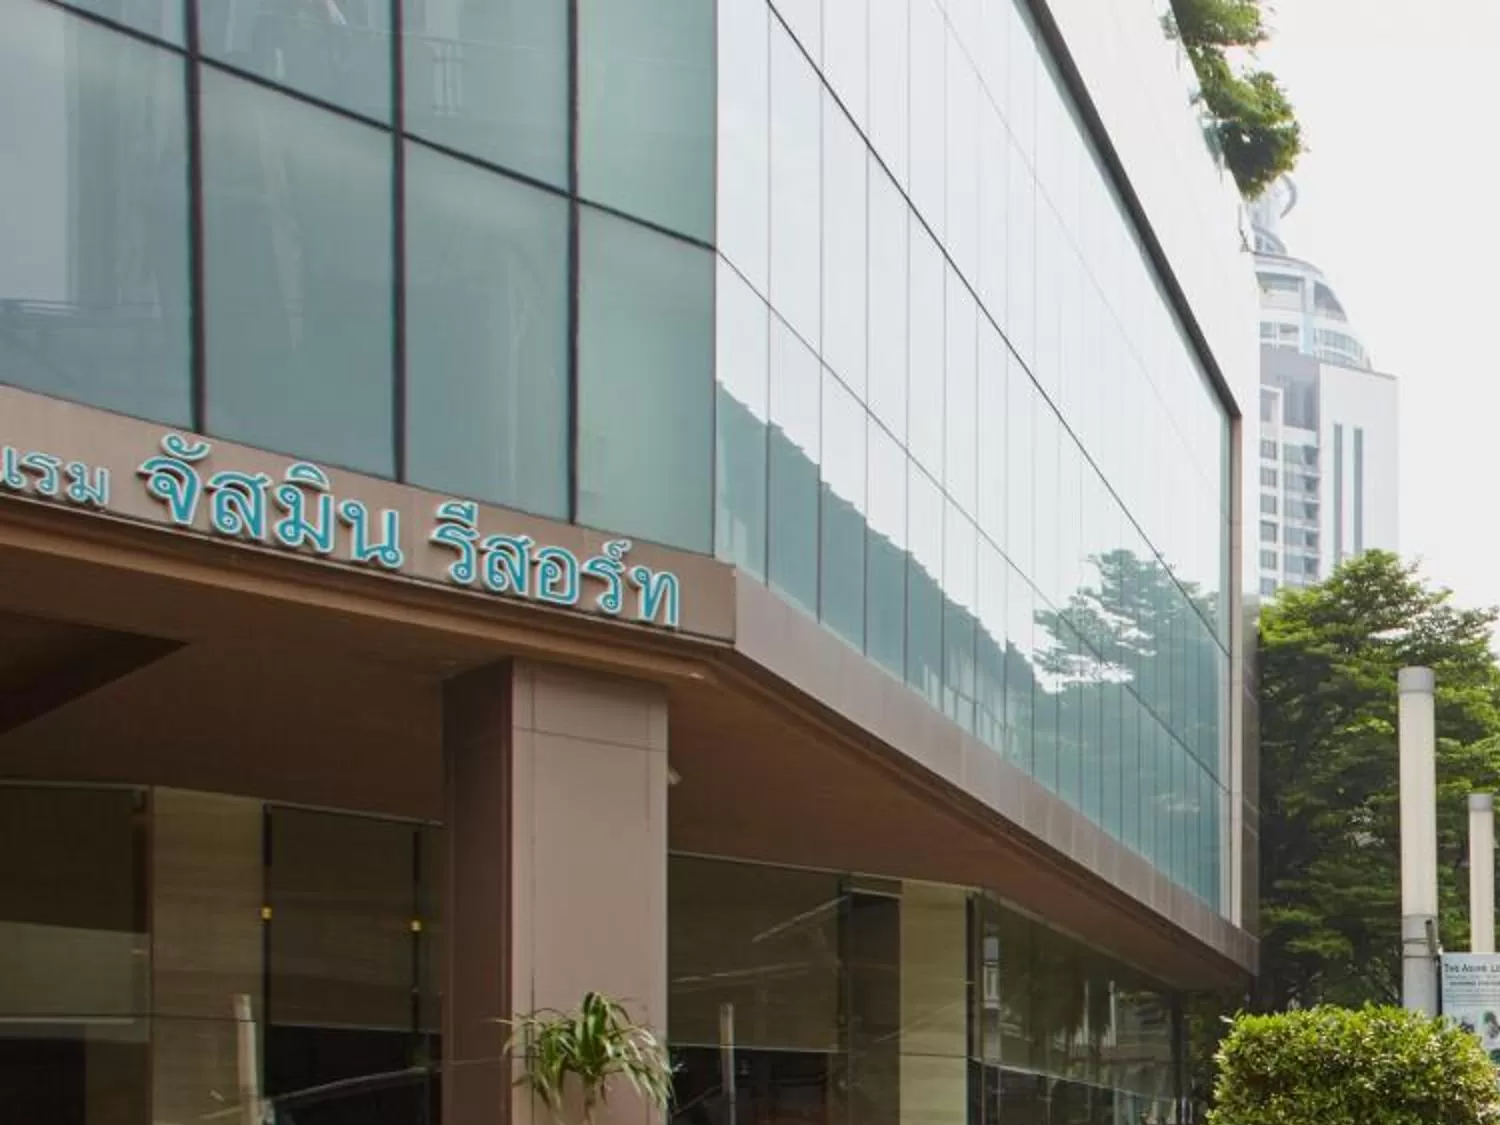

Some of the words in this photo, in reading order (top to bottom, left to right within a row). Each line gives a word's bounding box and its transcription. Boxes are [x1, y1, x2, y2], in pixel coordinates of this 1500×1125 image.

[138, 432, 404, 568] จัสมิน
[431, 500, 680, 628] รีสอร์ท
